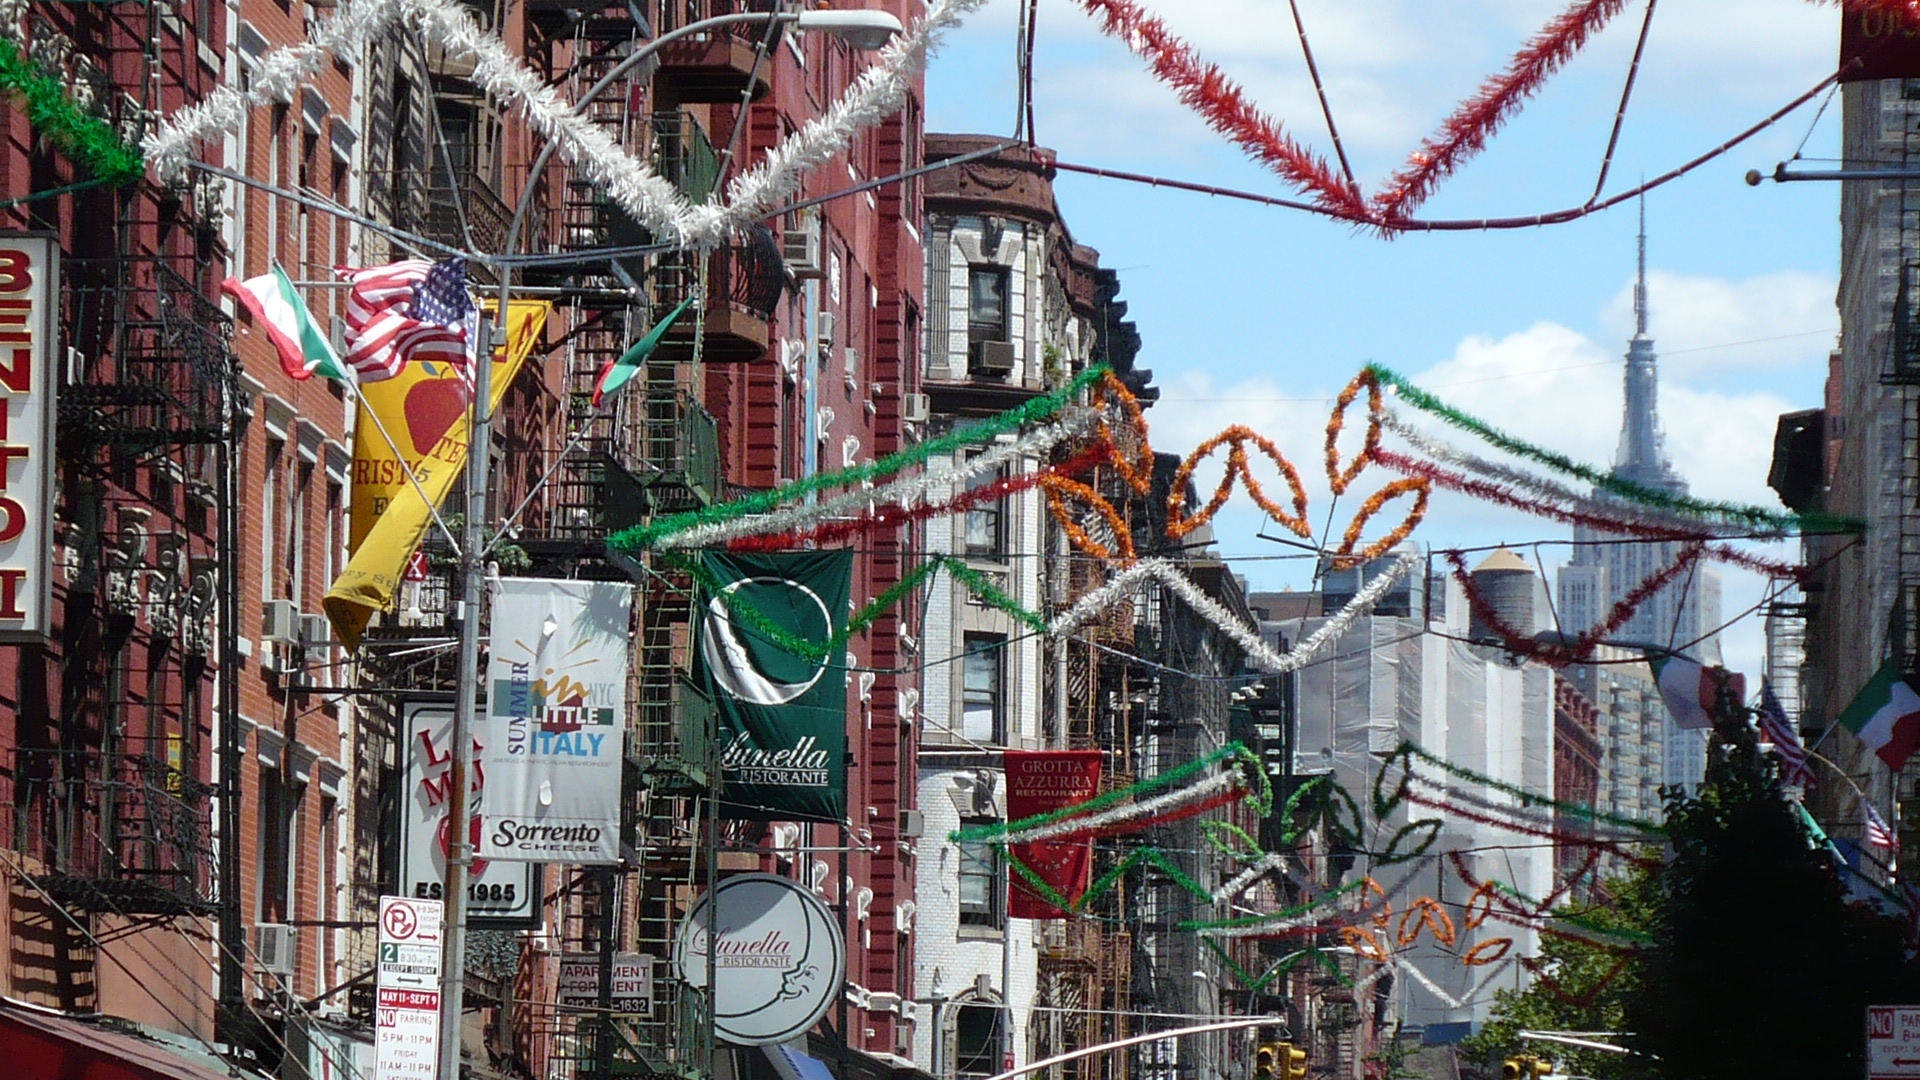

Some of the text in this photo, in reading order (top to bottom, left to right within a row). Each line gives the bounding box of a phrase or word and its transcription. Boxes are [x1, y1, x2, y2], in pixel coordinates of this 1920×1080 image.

[531, 668, 589, 703] in
[588, 682, 615, 706] NYC
[508, 661, 529, 755] SUMMER
[531, 705, 599, 725] LITTLE
[530, 731, 605, 757] ITALY
[1021, 760, 1084, 773] GROTTA
[740, 770, 829, 784] RISTORANTE
[1014, 775, 1092, 789] AZZURRA
[1015, 789, 1090, 798] RESTAURANT
[491, 819, 600, 848] Sorrento
[518, 842, 600, 853] CHEESE
[468, 883, 516, 901] 1985
[384, 943, 394, 962] 2
[723, 956, 791, 967] RISTORANTE
[565, 965, 649, 978] APARMENT
[569, 981, 597, 993] FOR
[381, 991, 398, 1002] MAY
[431, 995, 437, 1006] 9
[379, 1009, 433, 1026] NO PARKING
[1870, 1011, 1894, 1035] NO
[394, 1049, 418, 1058] FRIDAY
